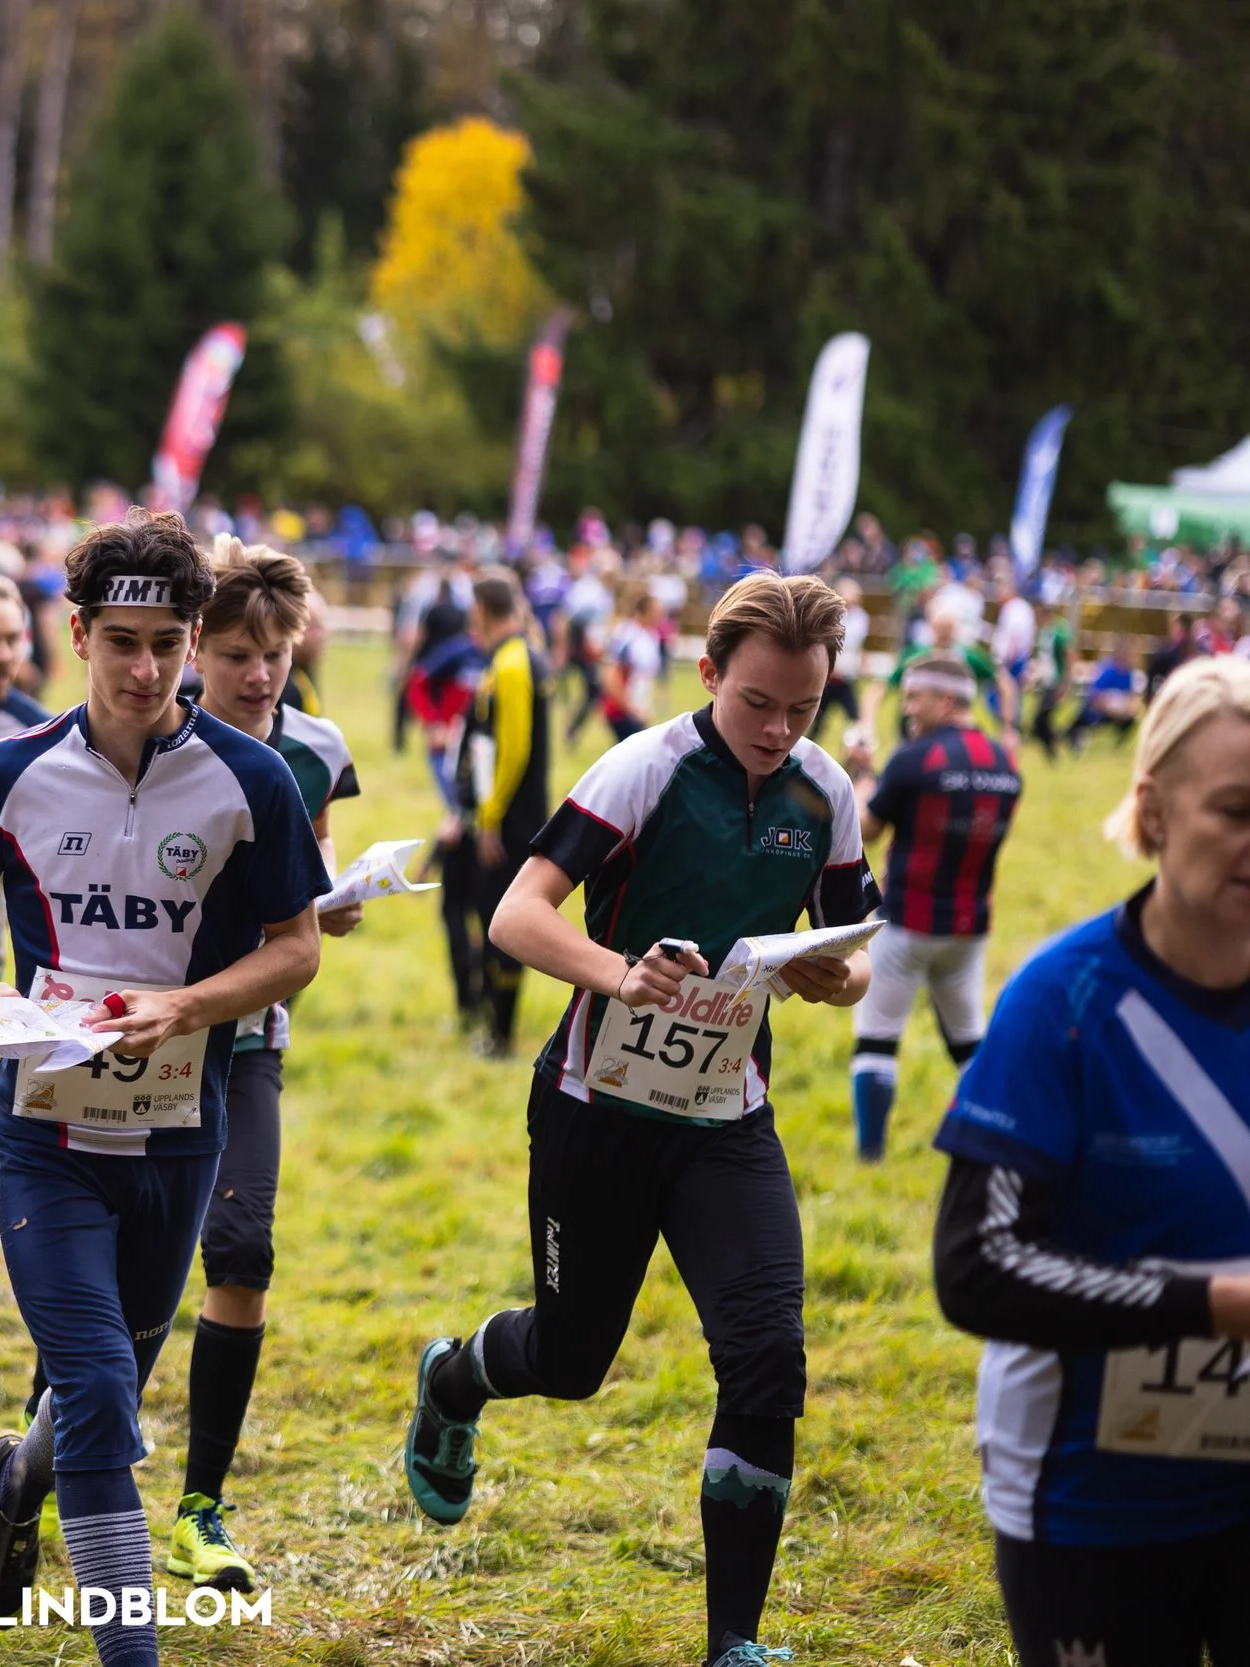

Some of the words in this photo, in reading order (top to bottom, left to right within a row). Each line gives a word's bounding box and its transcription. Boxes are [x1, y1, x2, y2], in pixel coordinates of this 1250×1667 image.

[167, 708, 199, 749] oname
[760, 826, 813, 851] JOK
[165, 845, 200, 858] TÄBY
[49, 883, 197, 934] TÄBY
[620, 1012, 730, 1075] 157
[158, 1061, 193, 1081] 3:4
[718, 1057, 742, 1074] 3:4
[153, 1093, 196, 1103] UPPLANDS
[153, 1103, 178, 1112] VÄSBY
